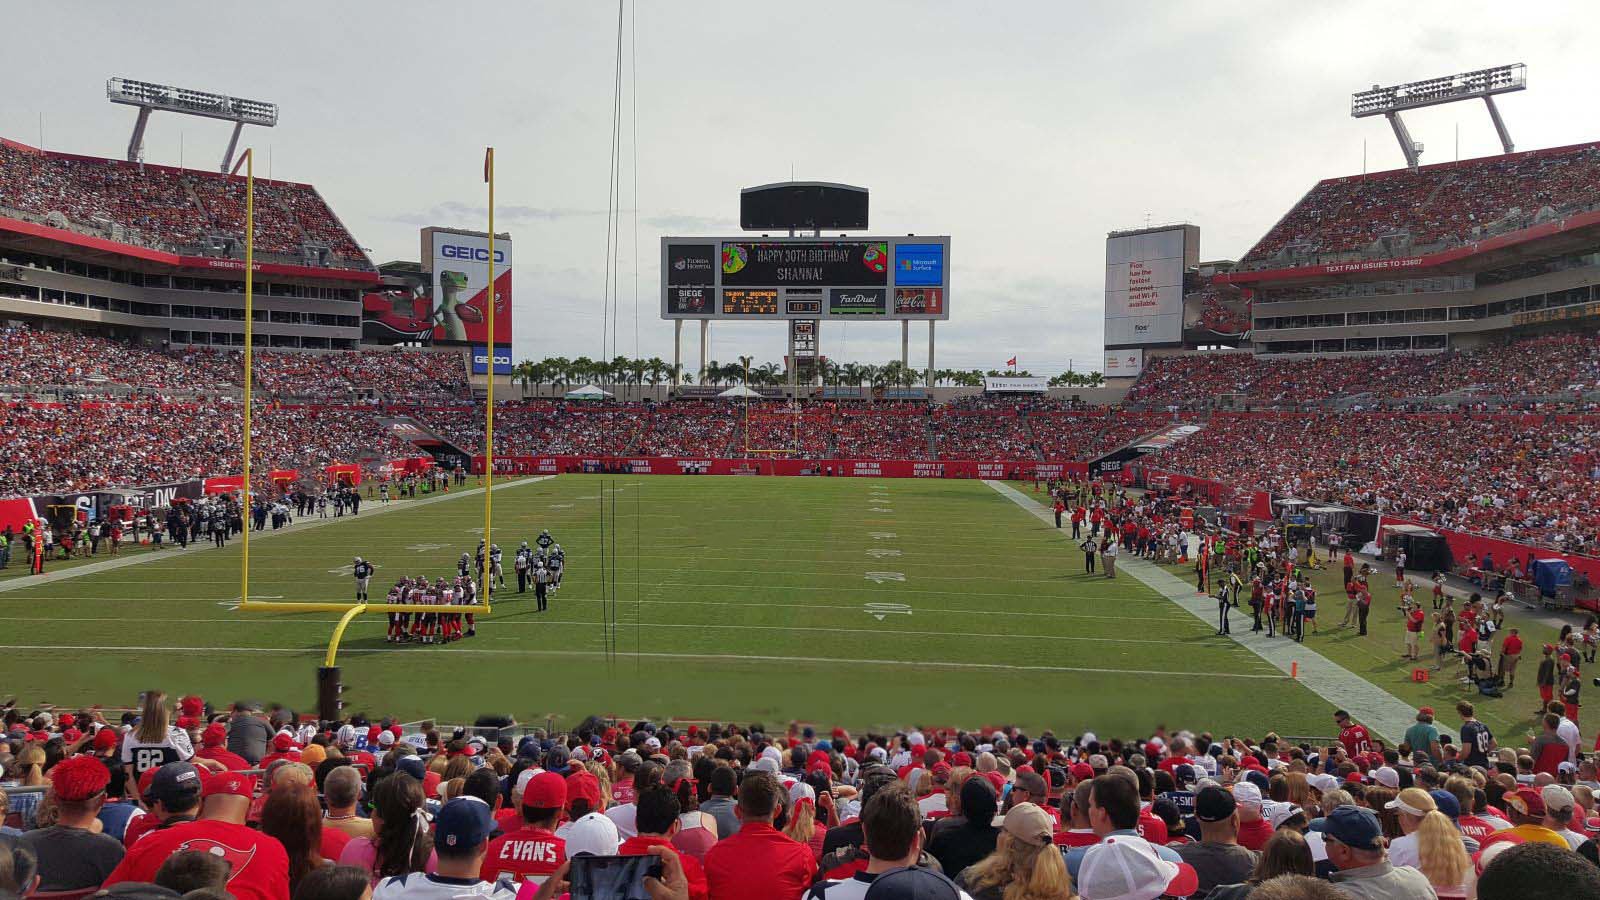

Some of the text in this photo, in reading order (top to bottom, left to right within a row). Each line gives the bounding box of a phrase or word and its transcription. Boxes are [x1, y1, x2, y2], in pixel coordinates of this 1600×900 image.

[441, 244, 505, 263] GEICO
[757, 248, 850, 263] HAPPY 30TH BIRTHDAY
[208, 260, 261, 270] #SIEGETHEAY
[1326, 265, 1344, 273] TEXT
[1345, 263, 1360, 272] FAN
[1361, 261, 1388, 270] ISSUES
[1390, 260, 1400, 268] TO
[776, 266, 823, 281] SHANNA!
[678, 289, 703, 297] SIEGE
[839, 294, 878, 304] FanDuel
[474, 355, 510, 365] GECO
[1100, 460, 1121, 471] SIEGE
[154, 487, 177, 508] DAY
[137, 749, 164, 772] 82
[1172, 796, 1193, 807] E.SMI
[499, 840, 557, 863] EVANS
